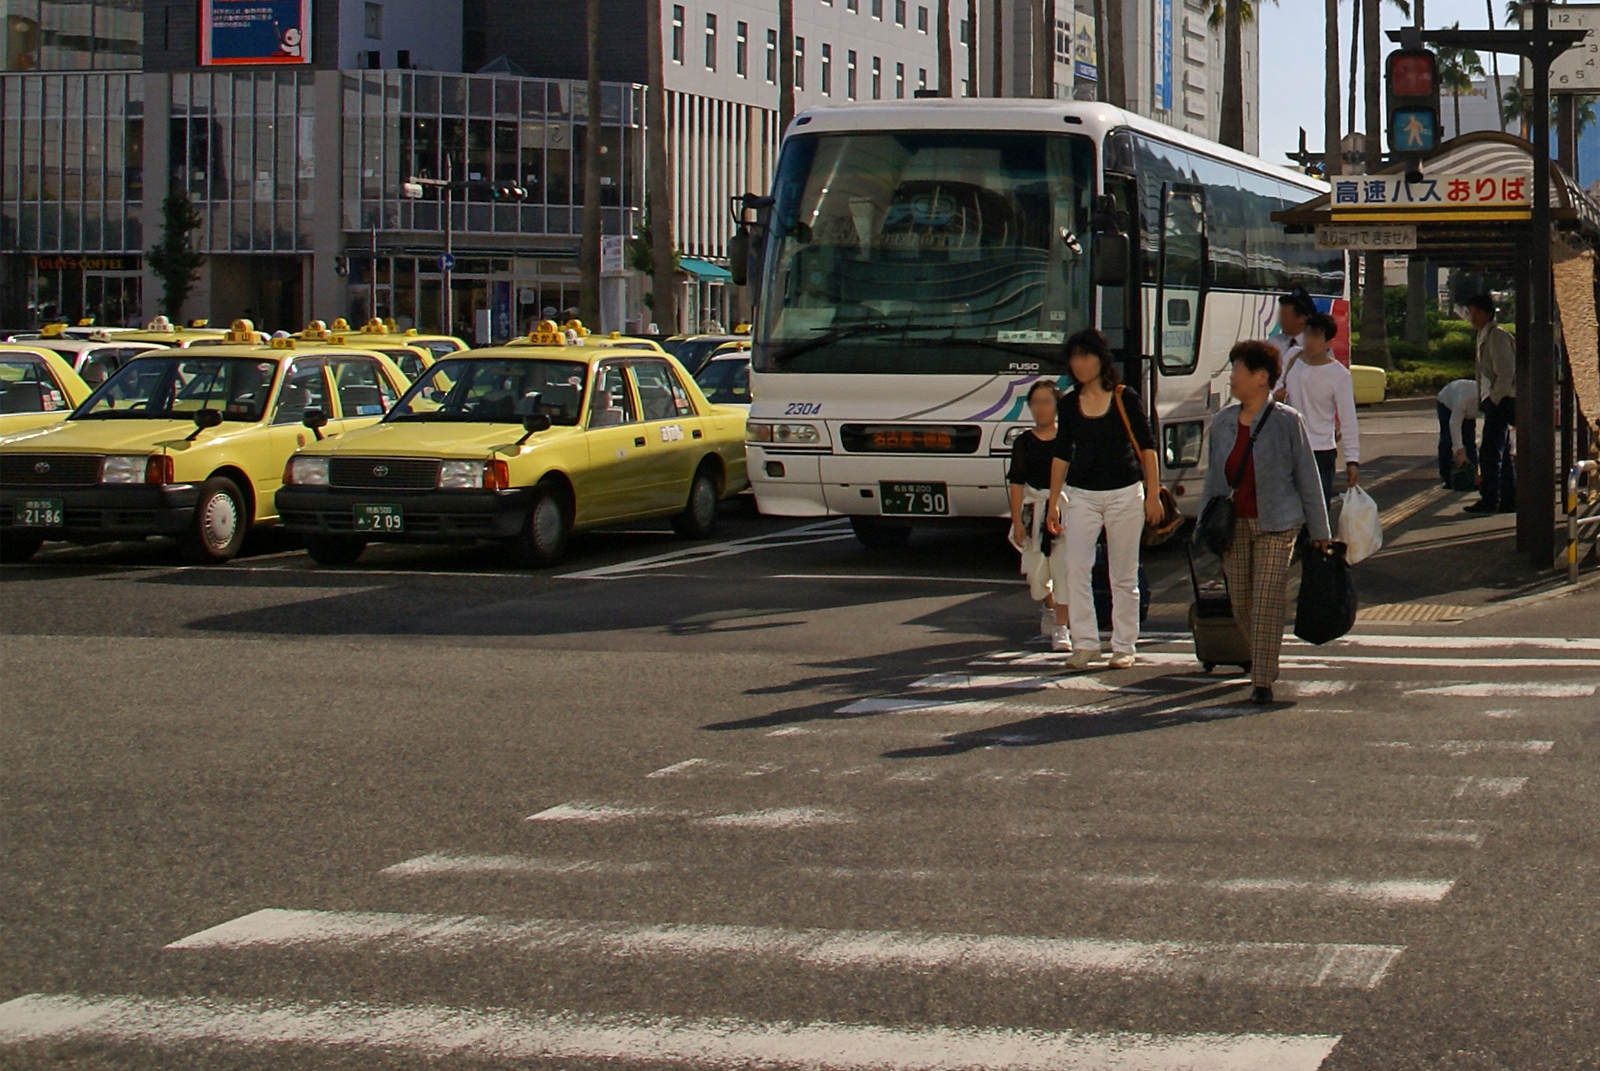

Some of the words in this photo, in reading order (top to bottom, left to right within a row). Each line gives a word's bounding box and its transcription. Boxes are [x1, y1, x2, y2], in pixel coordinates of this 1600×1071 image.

[1558, 14, 1570, 23] 12
[1589, 44, 1599, 53] 3
[1585, 58, 1595, 67] 4
[1575, 70, 1585, 79] 5
[1559, 75, 1569, 84] 6
[531, 332, 562, 343] さかえ
[1009, 362, 1040, 370] FUSO
[784, 402, 822, 416] 2304
[25, 509, 61, 523] 21-86
